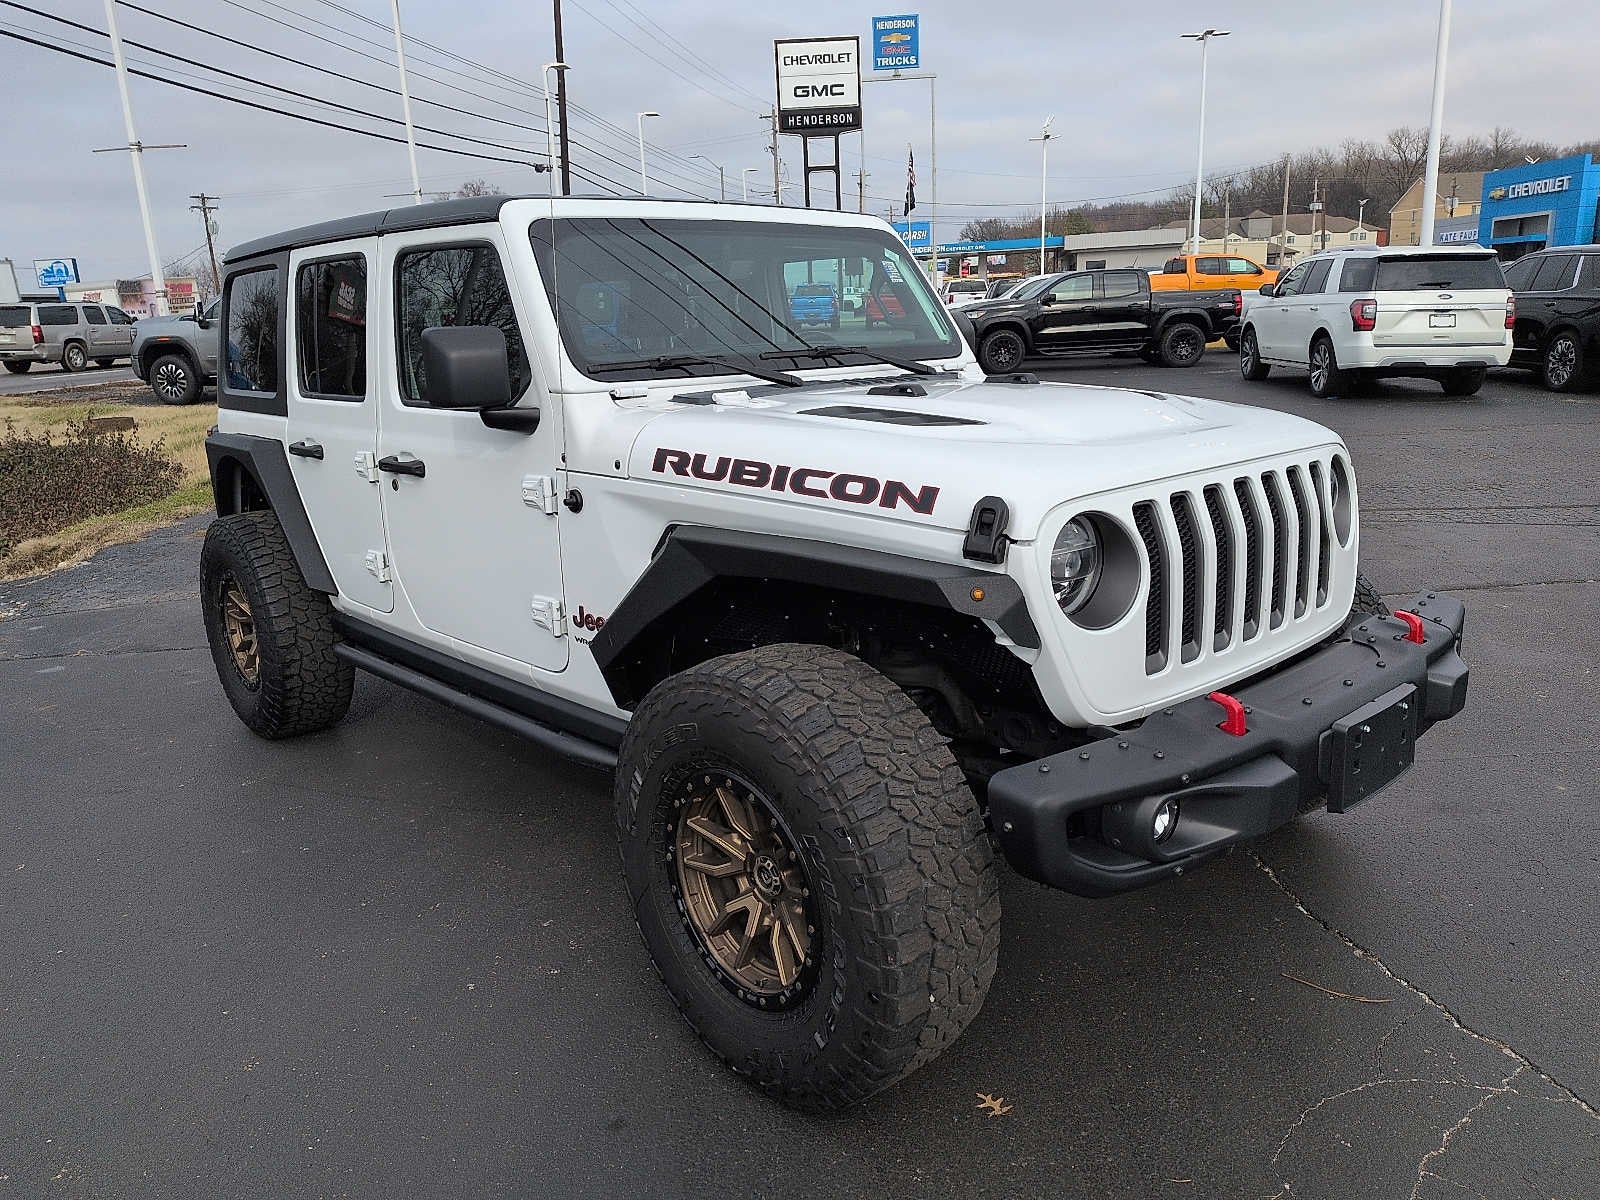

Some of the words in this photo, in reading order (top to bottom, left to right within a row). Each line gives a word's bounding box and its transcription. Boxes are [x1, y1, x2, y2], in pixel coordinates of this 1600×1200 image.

[876, 19, 916, 30] HENDERSON
[783, 53, 852, 66] CHEVROLET
[876, 56, 917, 67] TRUCKS
[793, 83, 845, 98] GMC
[788, 112, 853, 127] HENDERSON
[1508, 175, 1572, 199] CHEVROLET
[910, 245, 945, 254] ENDERON
[651, 447, 941, 515] RUBICON
[572, 604, 606, 632] Jee
